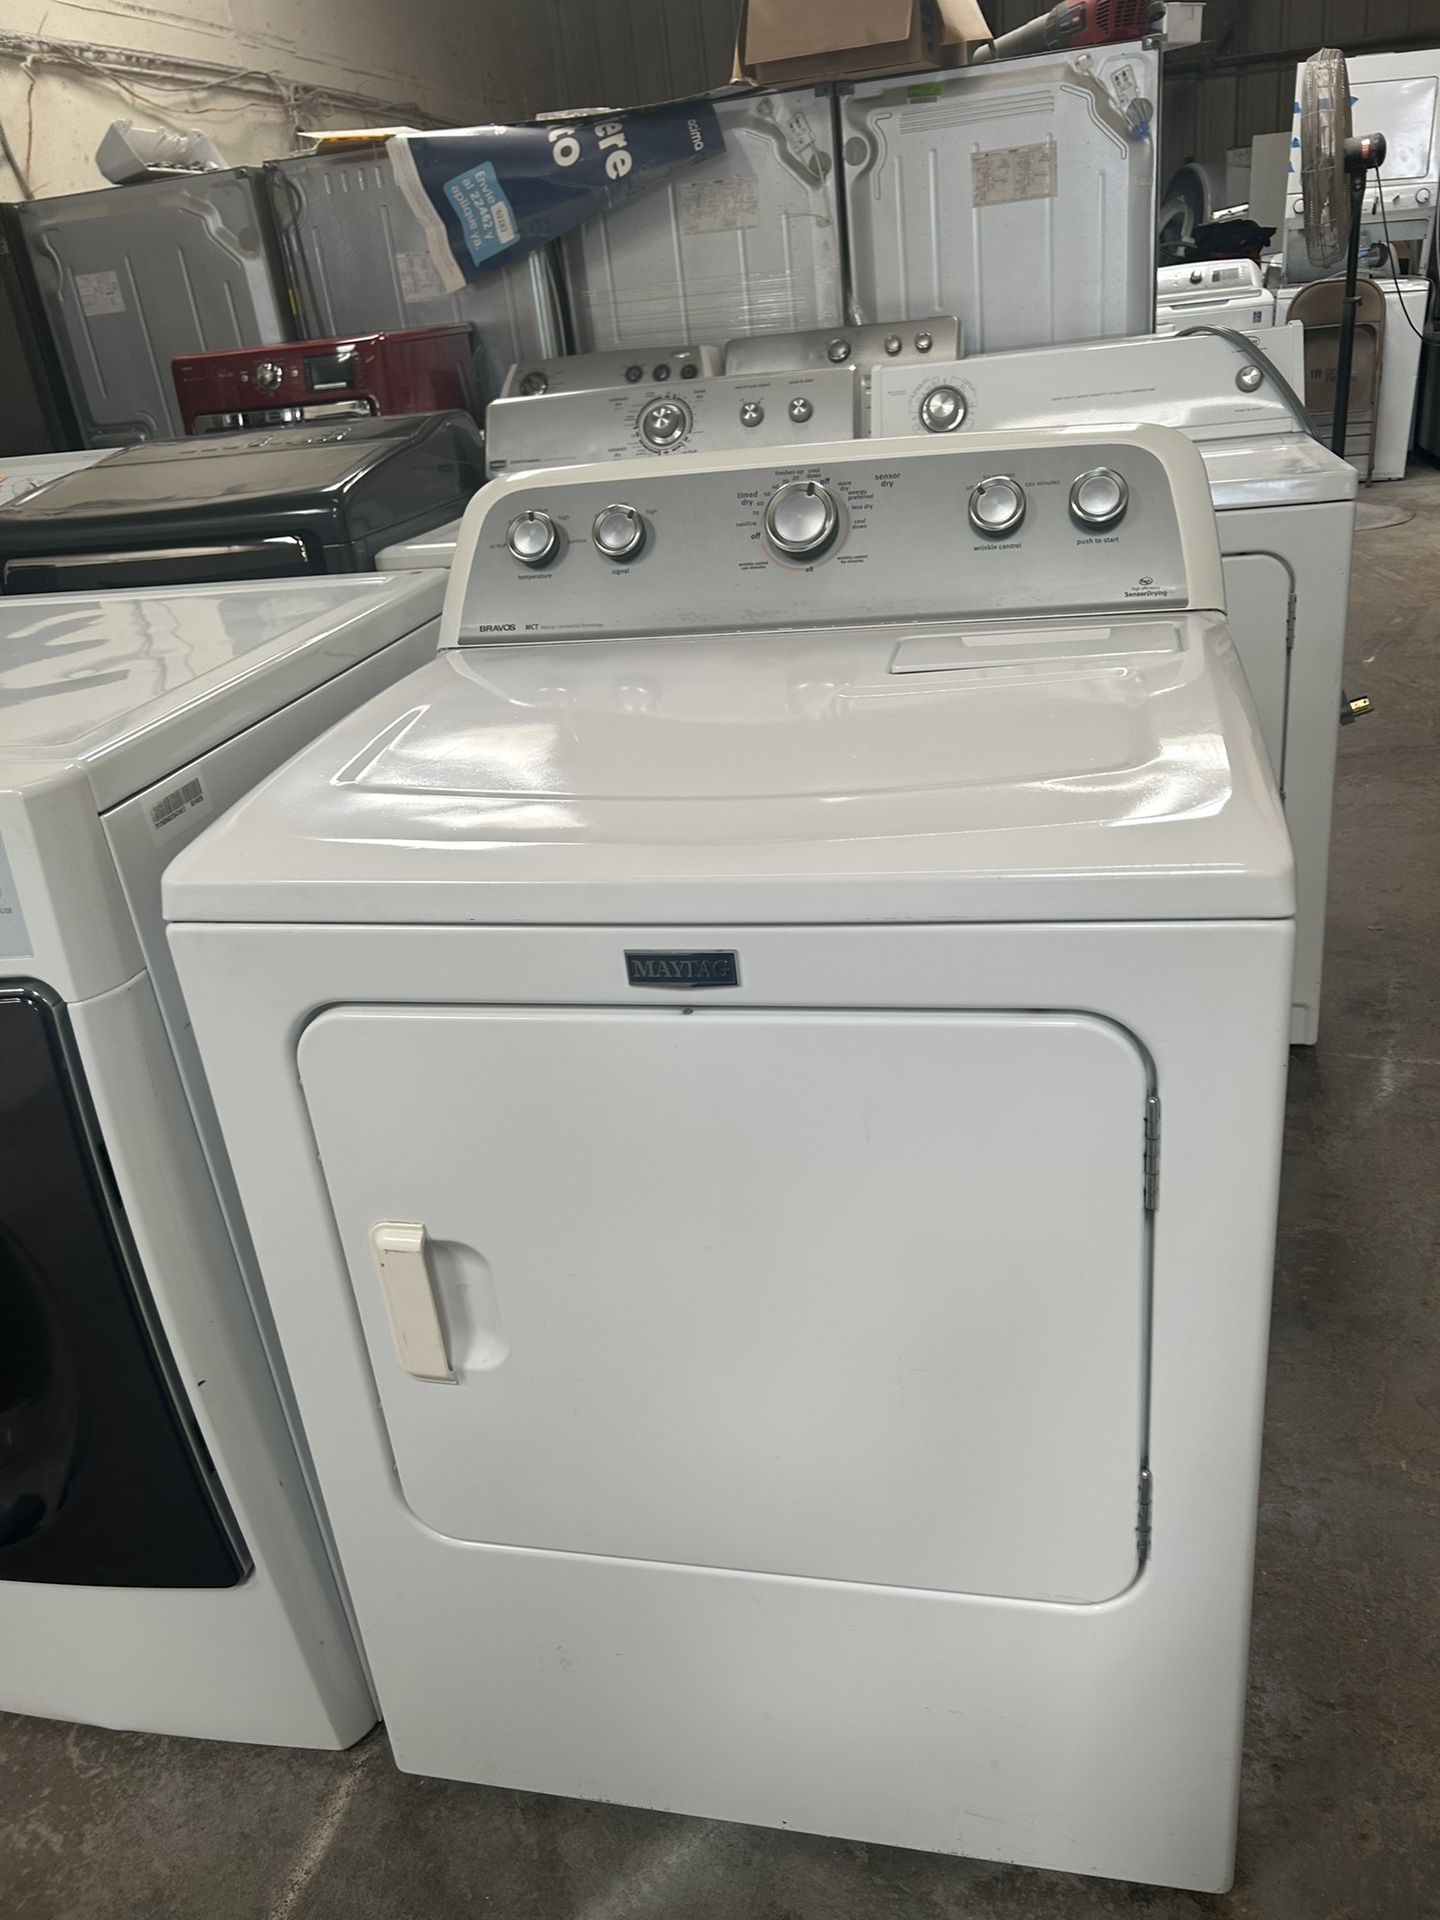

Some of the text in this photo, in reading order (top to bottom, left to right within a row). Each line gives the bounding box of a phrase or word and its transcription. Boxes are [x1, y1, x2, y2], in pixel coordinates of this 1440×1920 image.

[450, 185, 478, 230] aplique
[875, 472, 901, 481] sensor
[820, 478, 831, 486] off
[881, 480, 895, 488] dry
[737, 491, 758, 499] timed
[741, 499, 754, 507] dry
[751, 532, 762, 540] off
[1077, 538, 1094, 546] push
[974, 543, 998, 551] wrinkle
[1124, 590, 1168, 598] SensorDrying
[479, 624, 516, 632] BRAVOS
[632, 960, 732, 978] MAYTAG
